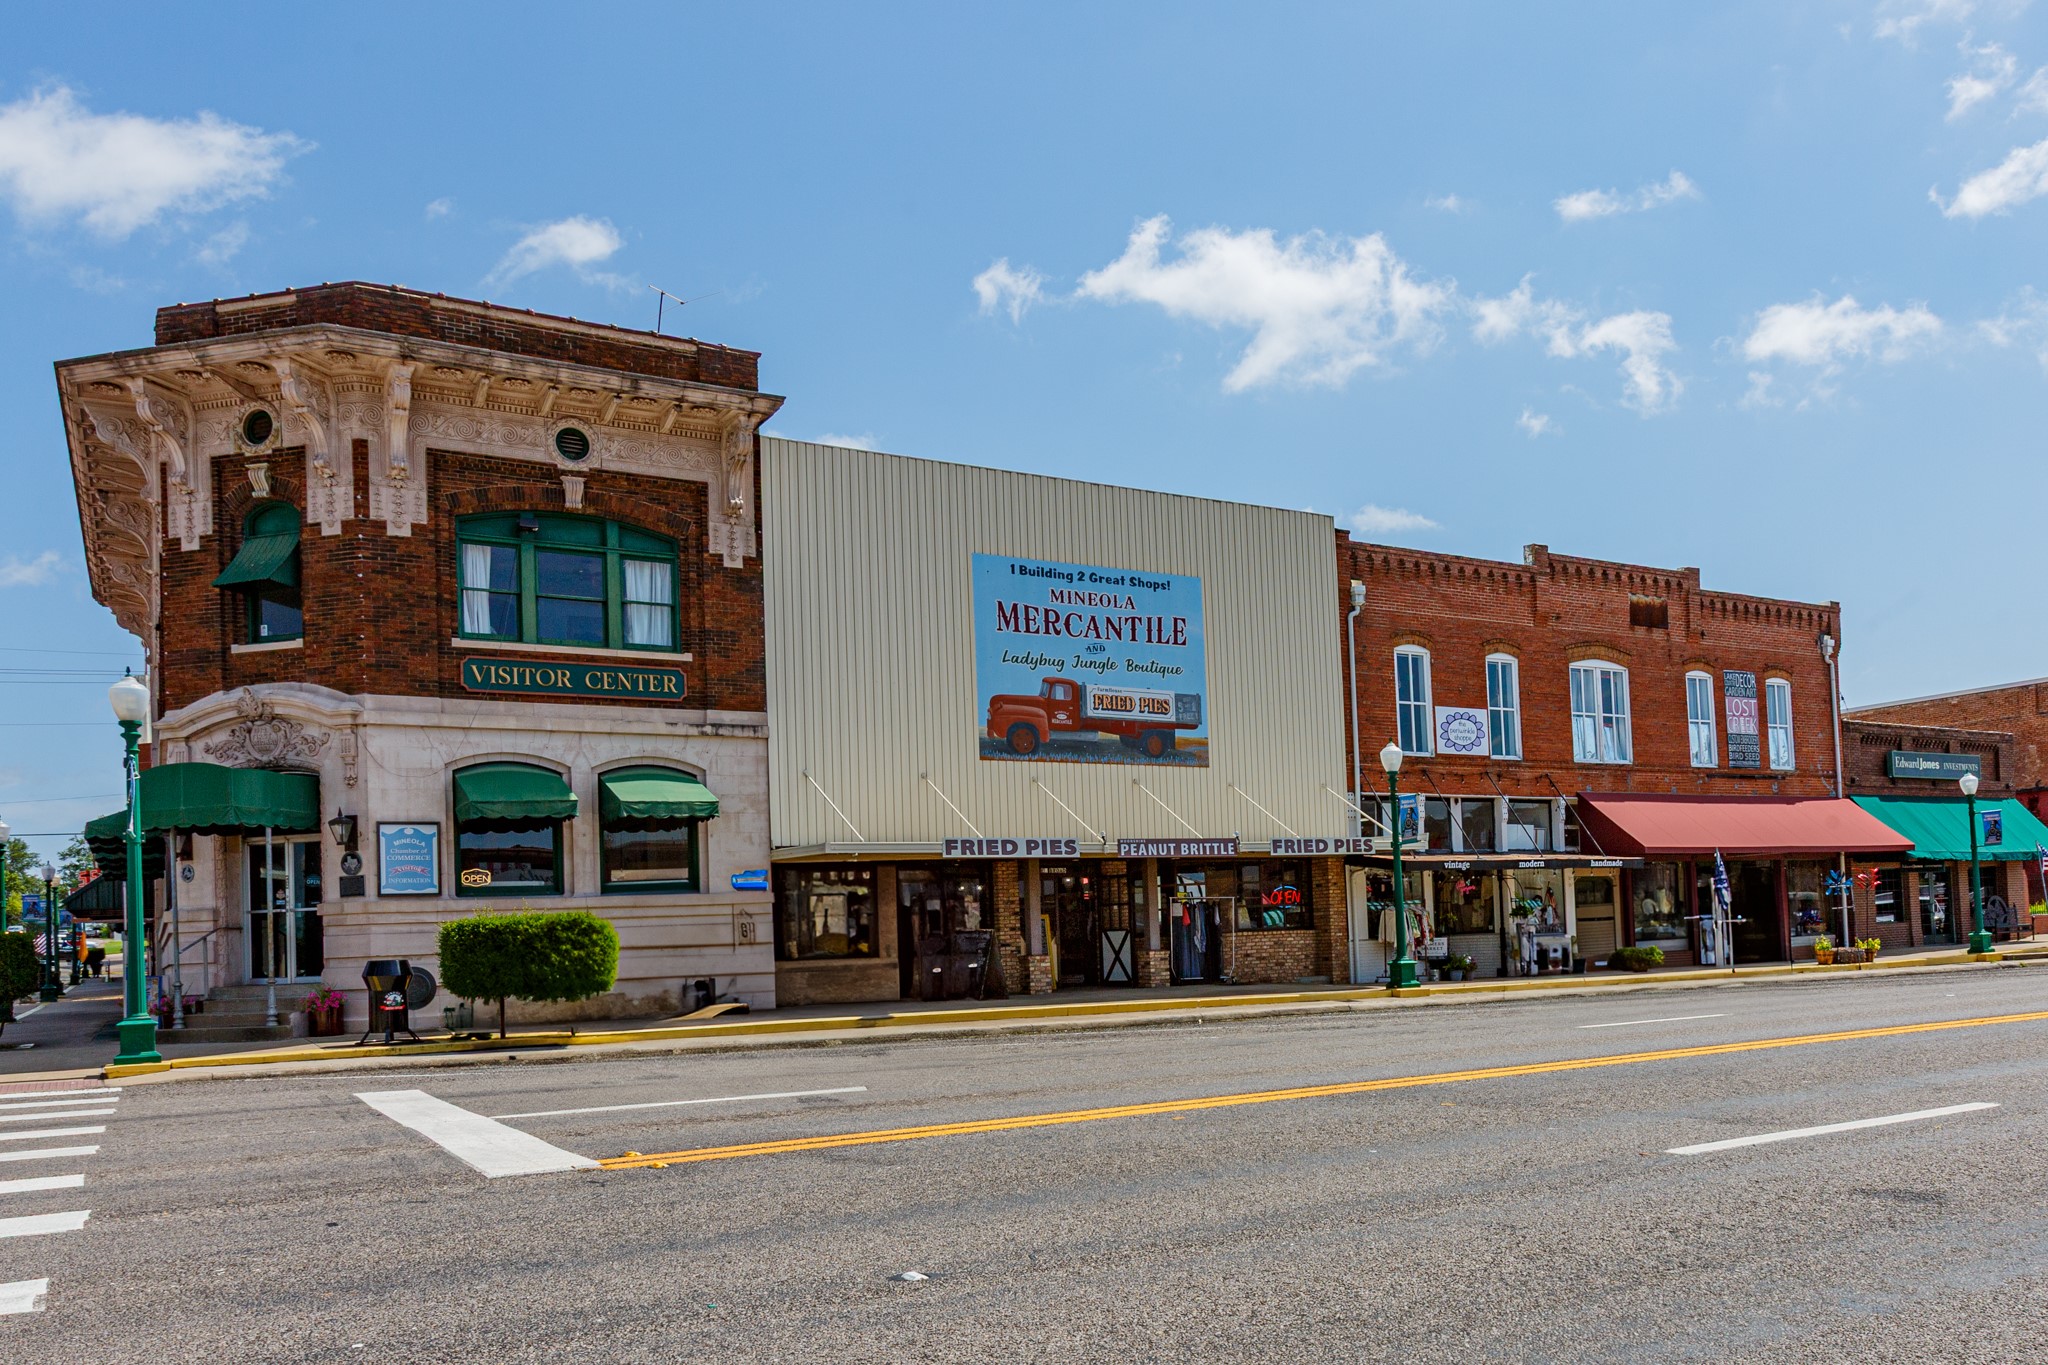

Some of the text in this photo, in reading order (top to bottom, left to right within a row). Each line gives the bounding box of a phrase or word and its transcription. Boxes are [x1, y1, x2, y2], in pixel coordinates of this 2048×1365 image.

[1010, 564, 1171, 592] 1 Building 2 Great Shops!
[1050, 588, 1136, 610] MINEOLA
[996, 600, 1187, 646] MERCANTILE
[1085, 644, 1106, 653] AND
[1002, 650, 1183, 678] Ladybug Jungle Boutique
[470, 664, 678, 693] VISITOR CENTER
[1736, 674, 1756, 688] DECOR
[1725, 686, 1756, 697] GARDEN ART
[1093, 694, 1170, 715] FRIED PIES
[1726, 699, 1757, 716] LOST
[1727, 717, 1758, 734] CREEK
[1729, 752, 1760, 760] BIRD SEED
[1944, 762, 1978, 771] INVESTMENTS
[393, 838, 425, 847] MINEOLA
[945, 839, 1077, 856] FRIED PIES
[1120, 843, 1235, 856] PEANUT BRITTLE
[1272, 839, 1373, 853] FRIED PIES
[1444, 861, 1470, 870] vintage
[1519, 860, 1544, 868] modern
[1271, 890, 1300, 904] OPEN
